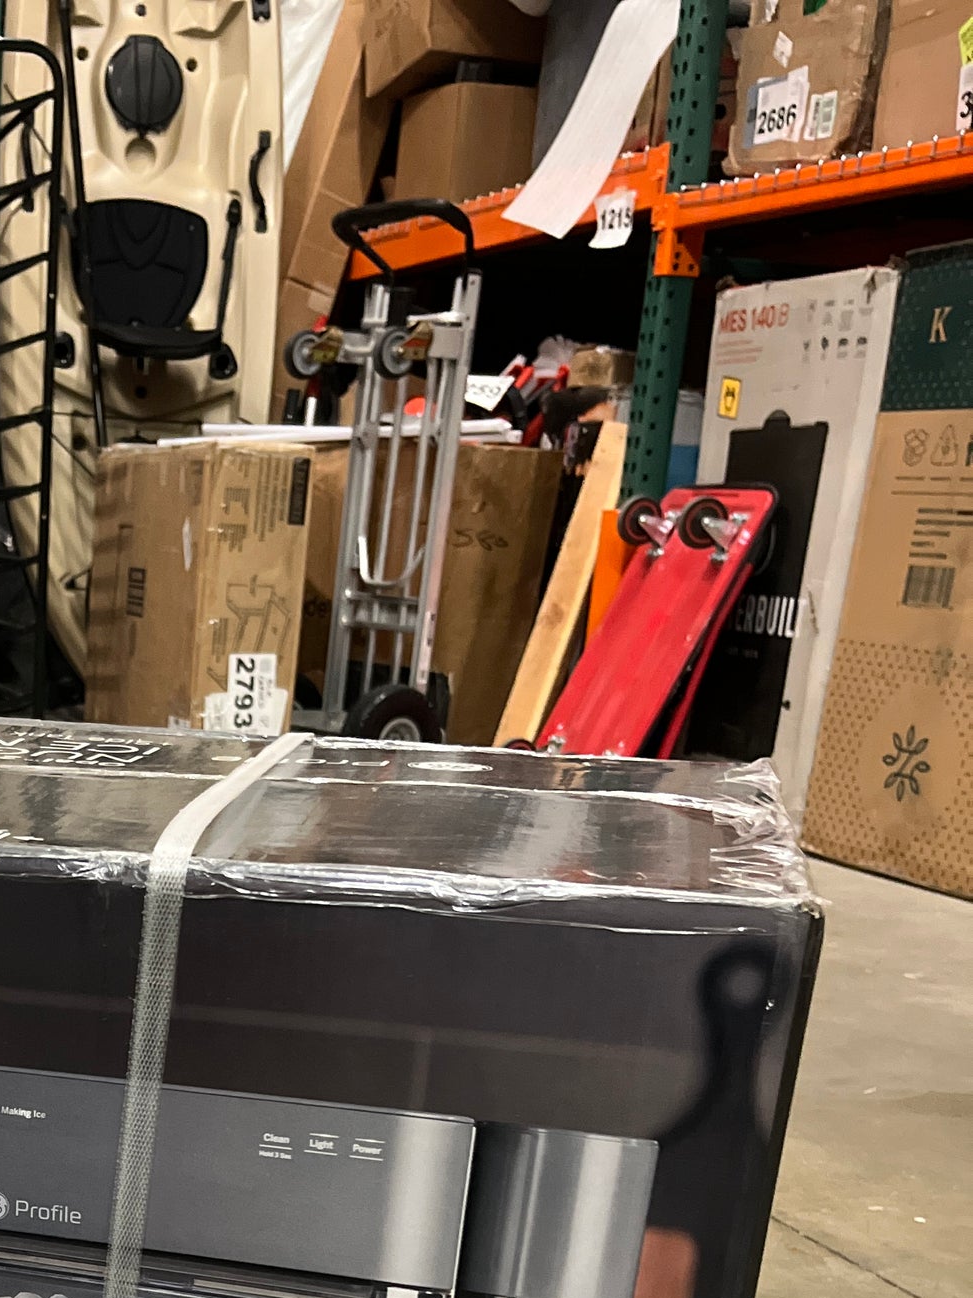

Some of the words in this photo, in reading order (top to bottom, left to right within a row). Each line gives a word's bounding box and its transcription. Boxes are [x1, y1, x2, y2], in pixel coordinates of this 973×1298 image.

[757, 103, 797, 135] 2686
[600, 206, 633, 230] 1215
[929, 306, 951, 344] K
[233, 657, 255, 729] 2793
[40, 739, 160, 756] ICE
[1, 1106, 31, 1119] Making
[33, 1110, 46, 1119] Ice
[263, 1133, 290, 1144] Clean
[309, 1139, 334, 1150] Light
[352, 1143, 382, 1155] Power
[15, 1199, 82, 1225] Profile
